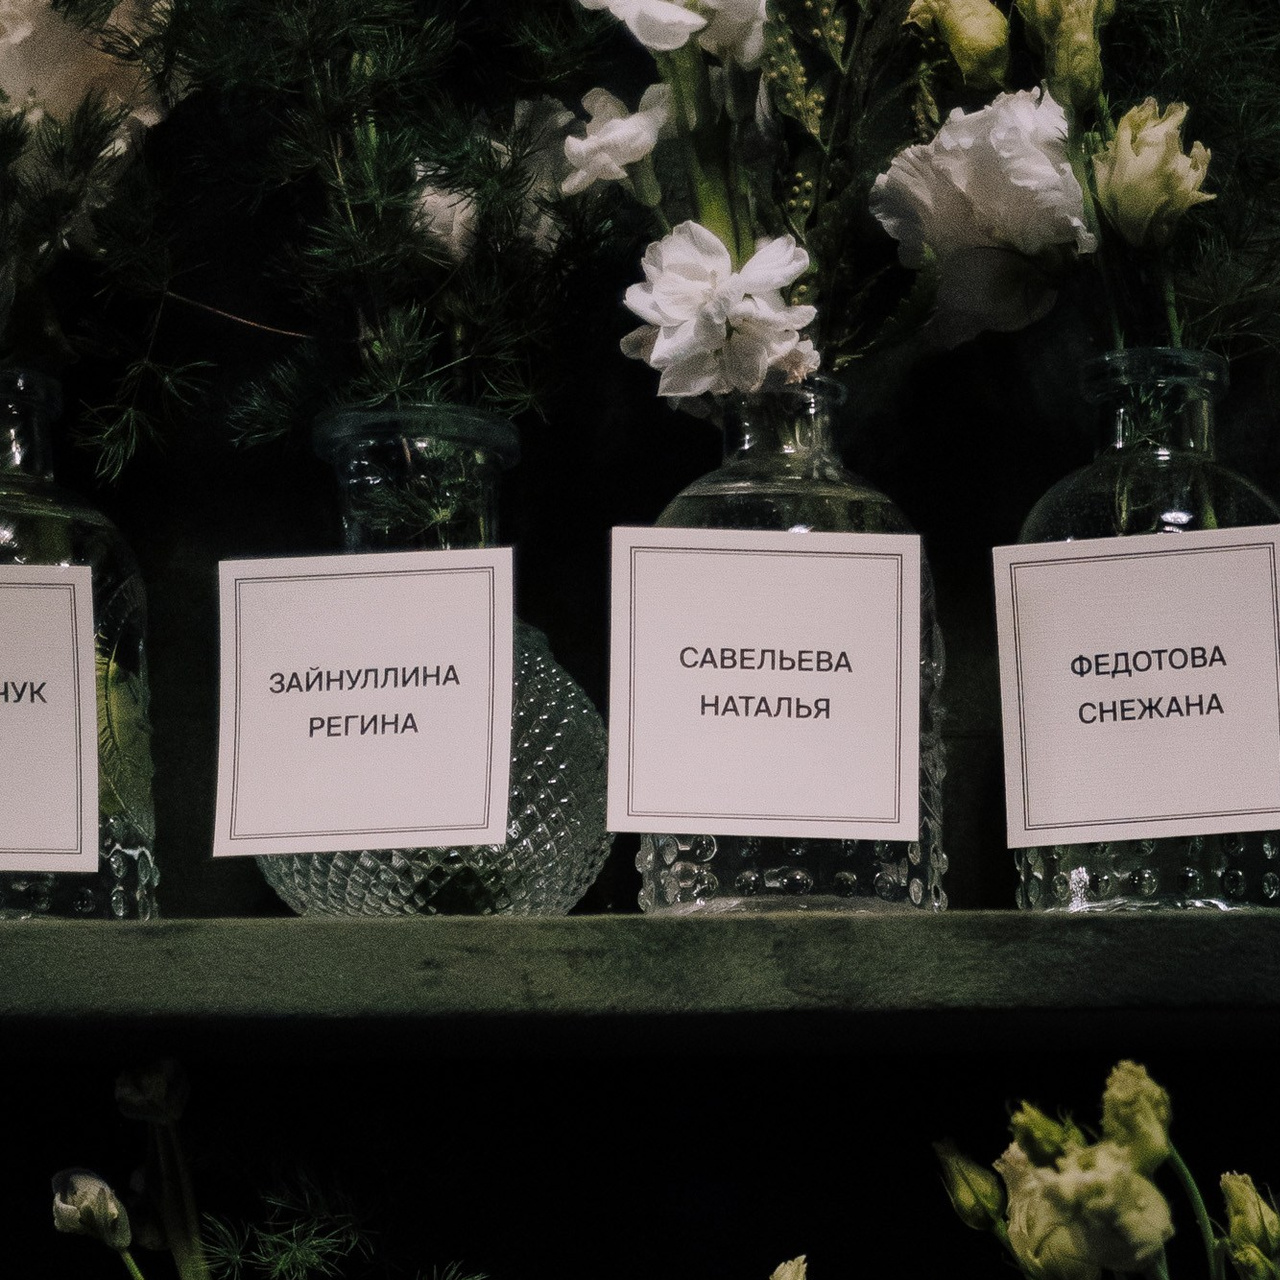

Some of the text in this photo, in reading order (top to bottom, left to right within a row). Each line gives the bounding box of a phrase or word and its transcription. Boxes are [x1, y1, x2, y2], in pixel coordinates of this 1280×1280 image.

[679, 646, 853, 673] САВЕЛЬЕВА
[1070, 645, 1227, 679] ФЕДОТОВА
[269, 664, 460, 694] ЗАЙНУЛЛИНА
[700, 694, 831, 719] НАТАЛЬЯ
[1078, 693, 1225, 725] СНЕЖАНА
[309, 712, 419, 738] РЕГИНА
